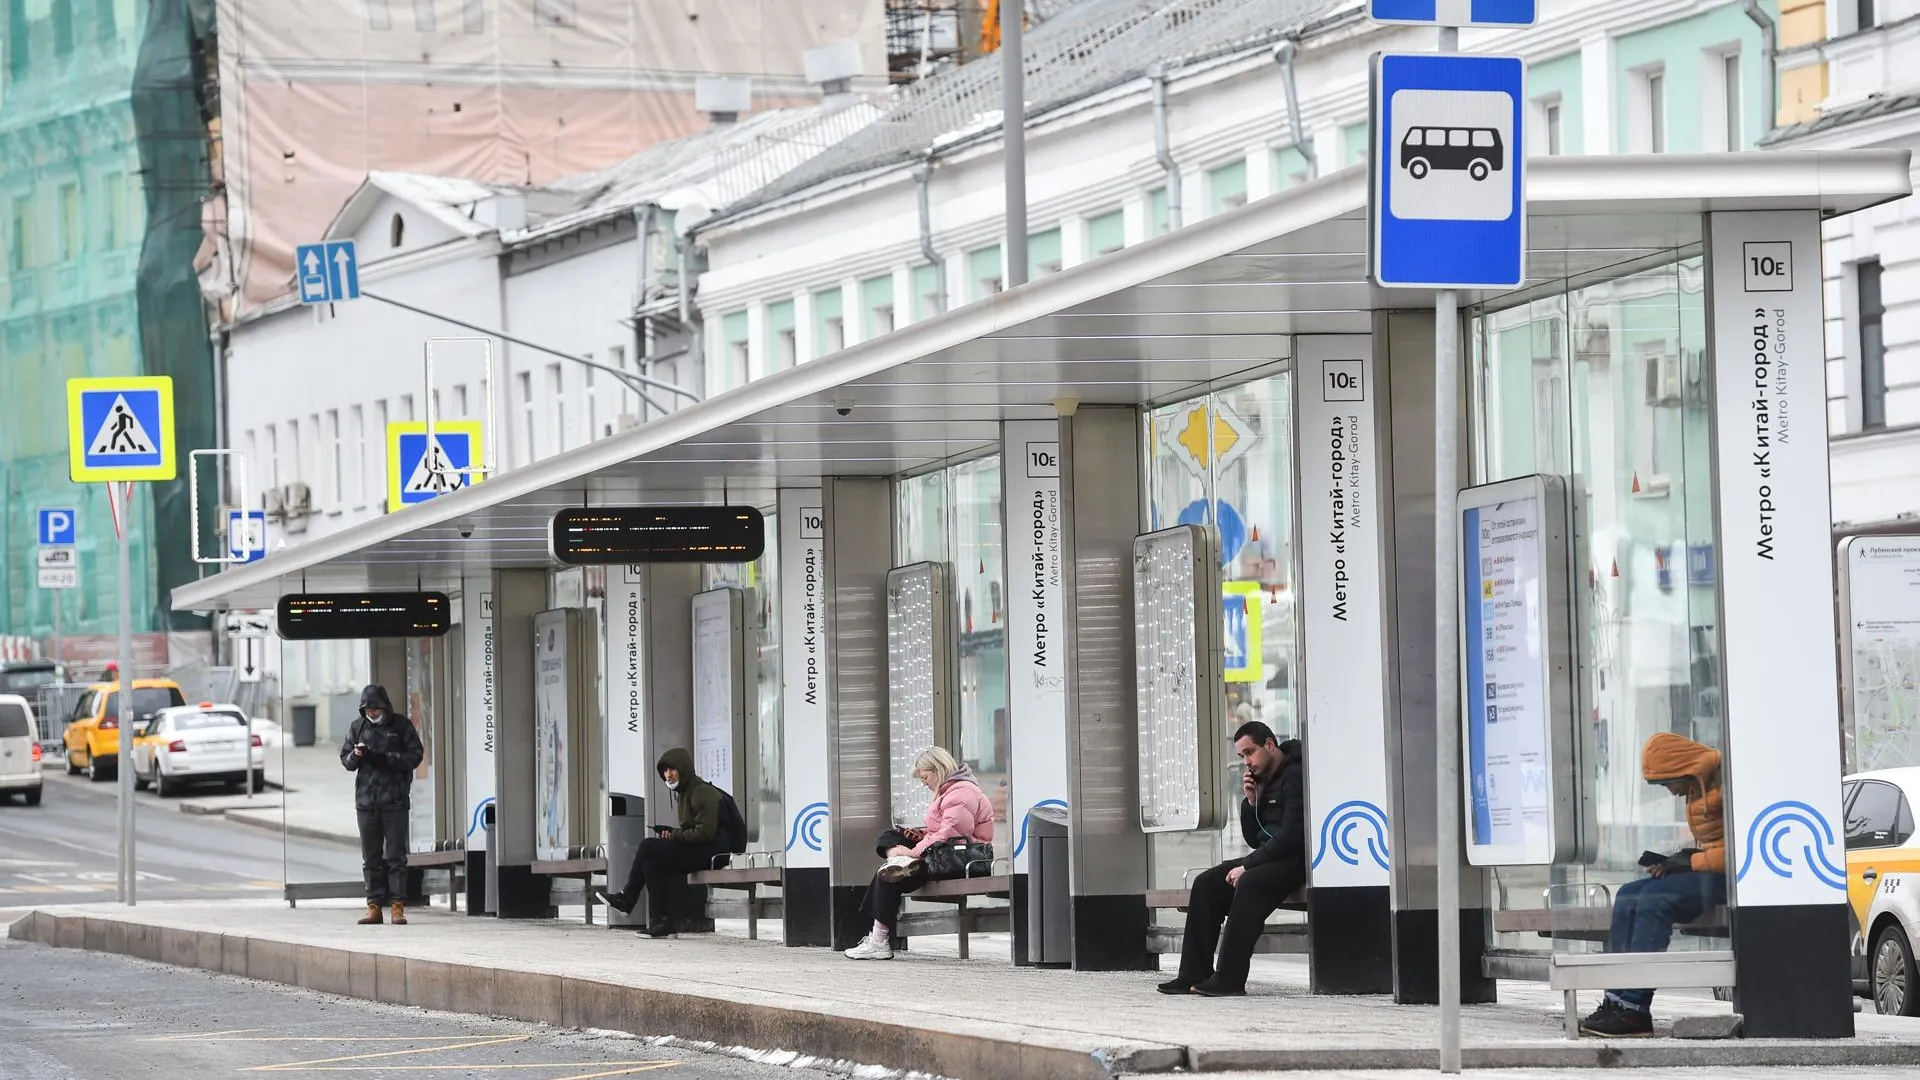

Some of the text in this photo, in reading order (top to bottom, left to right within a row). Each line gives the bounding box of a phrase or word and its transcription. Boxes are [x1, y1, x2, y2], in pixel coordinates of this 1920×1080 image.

[1773, 308, 1790, 445] Metro Kitay-Gorod
[1330, 415, 1348, 622] Метро «Китай-город»
[1348, 415, 1361, 529] Metro Kitay-Gorod
[48, 511, 70, 543] P
[804, 516, 823, 530] 10
[1047, 489, 1059, 587] Metro Kitay-Gorod
[1757, 485, 1777, 561] Метро
[803, 547, 817, 705] Метро «Китай-город»
[1031, 490, 1048, 667] Метро «Китай-город»
[484, 714, 494, 753] Метро
[627, 689, 639, 733] Метро
